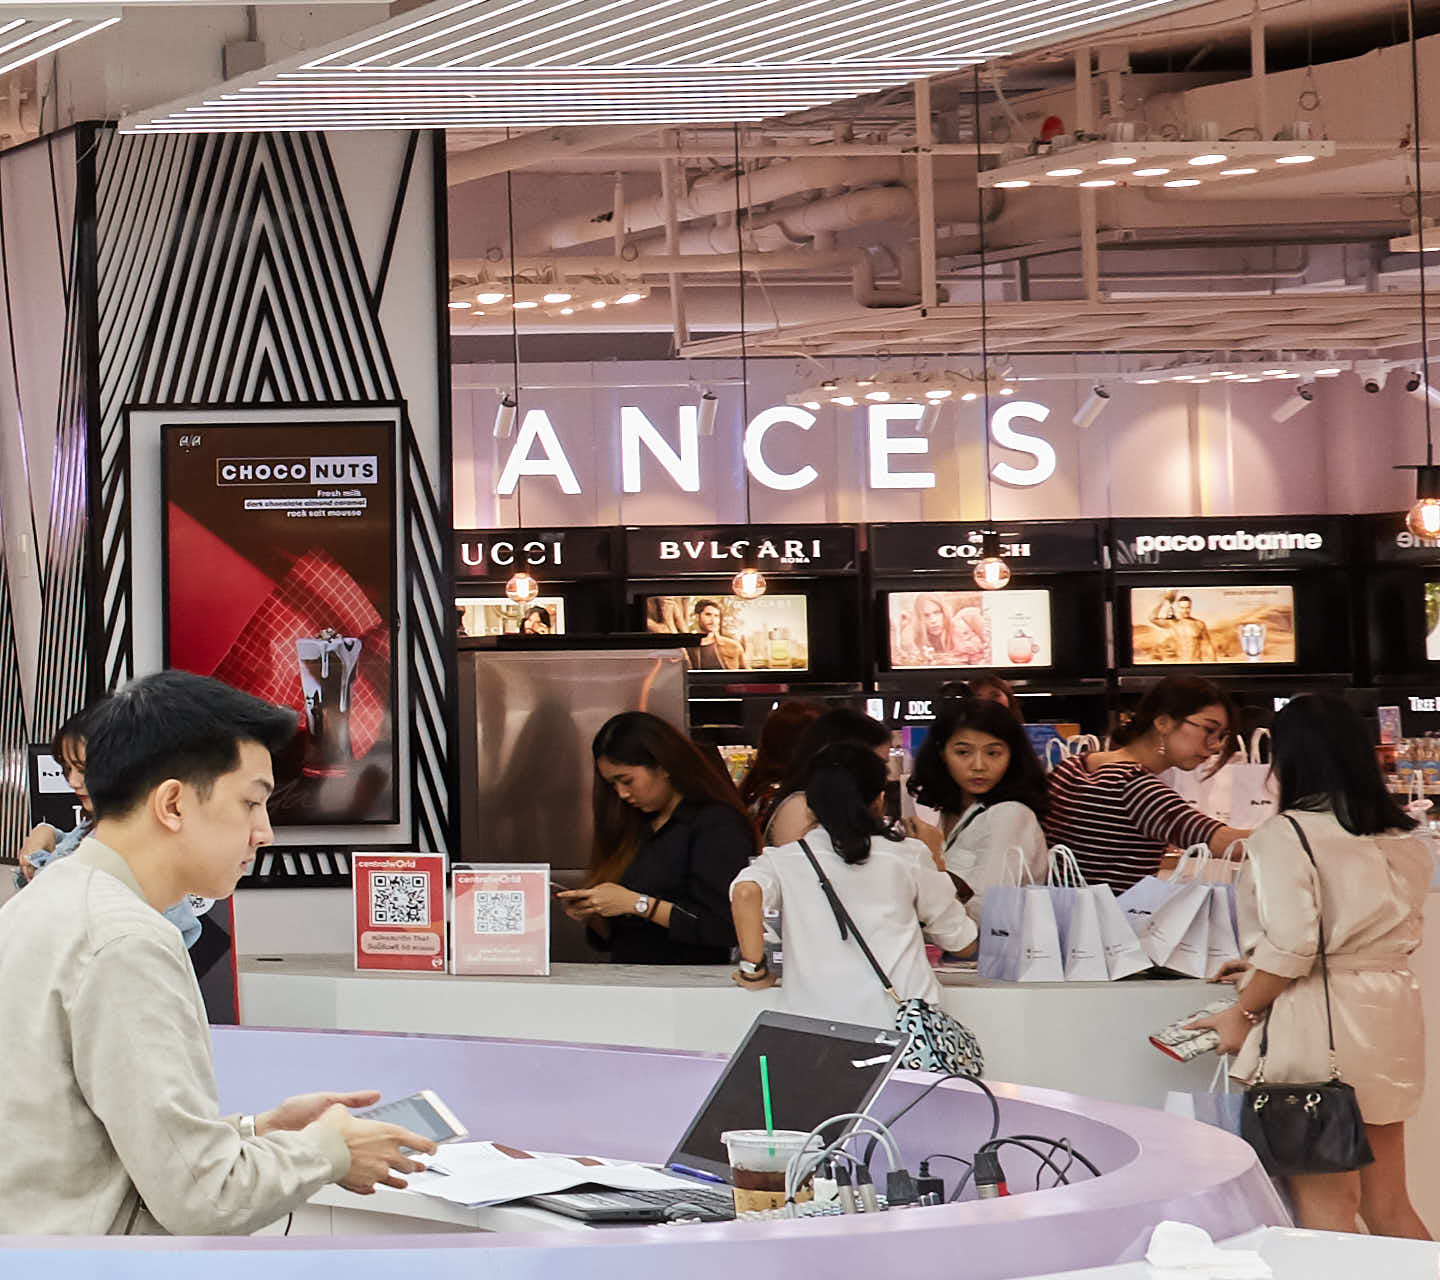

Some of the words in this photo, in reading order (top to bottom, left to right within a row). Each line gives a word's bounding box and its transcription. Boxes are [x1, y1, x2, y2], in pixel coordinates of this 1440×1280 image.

[221, 463, 307, 481] CHOCO
[315, 462, 374, 479] NUTS
[1135, 532, 1206, 556] paco
[1207, 530, 1323, 552] rabanne
